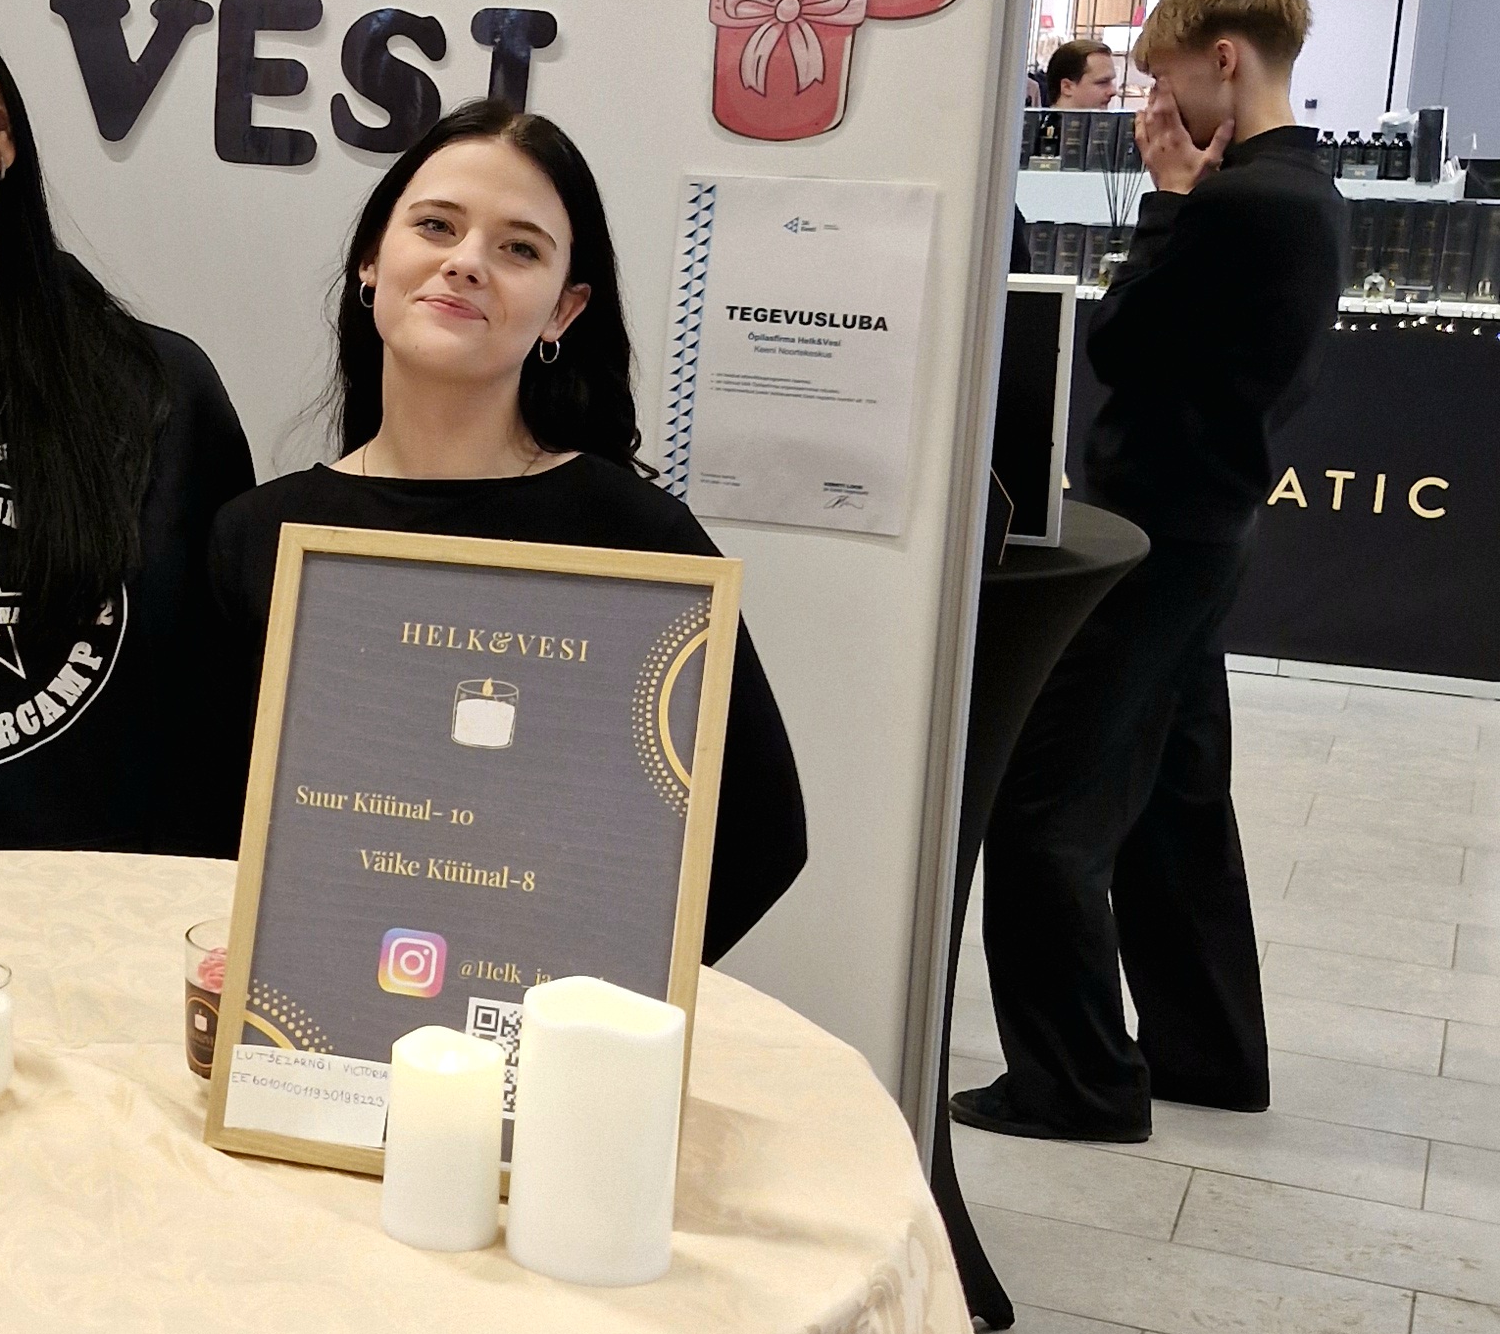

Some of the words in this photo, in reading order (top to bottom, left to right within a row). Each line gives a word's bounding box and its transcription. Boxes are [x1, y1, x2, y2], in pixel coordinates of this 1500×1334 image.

[726, 306, 888, 331] TEGEVUSLUBA
[1267, 467, 1449, 519] ATIC
[401, 622, 590, 662] HELK&VESI
[296, 785, 348, 810] Suur
[449, 808, 474, 826] 10
[360, 849, 421, 876] Väike
